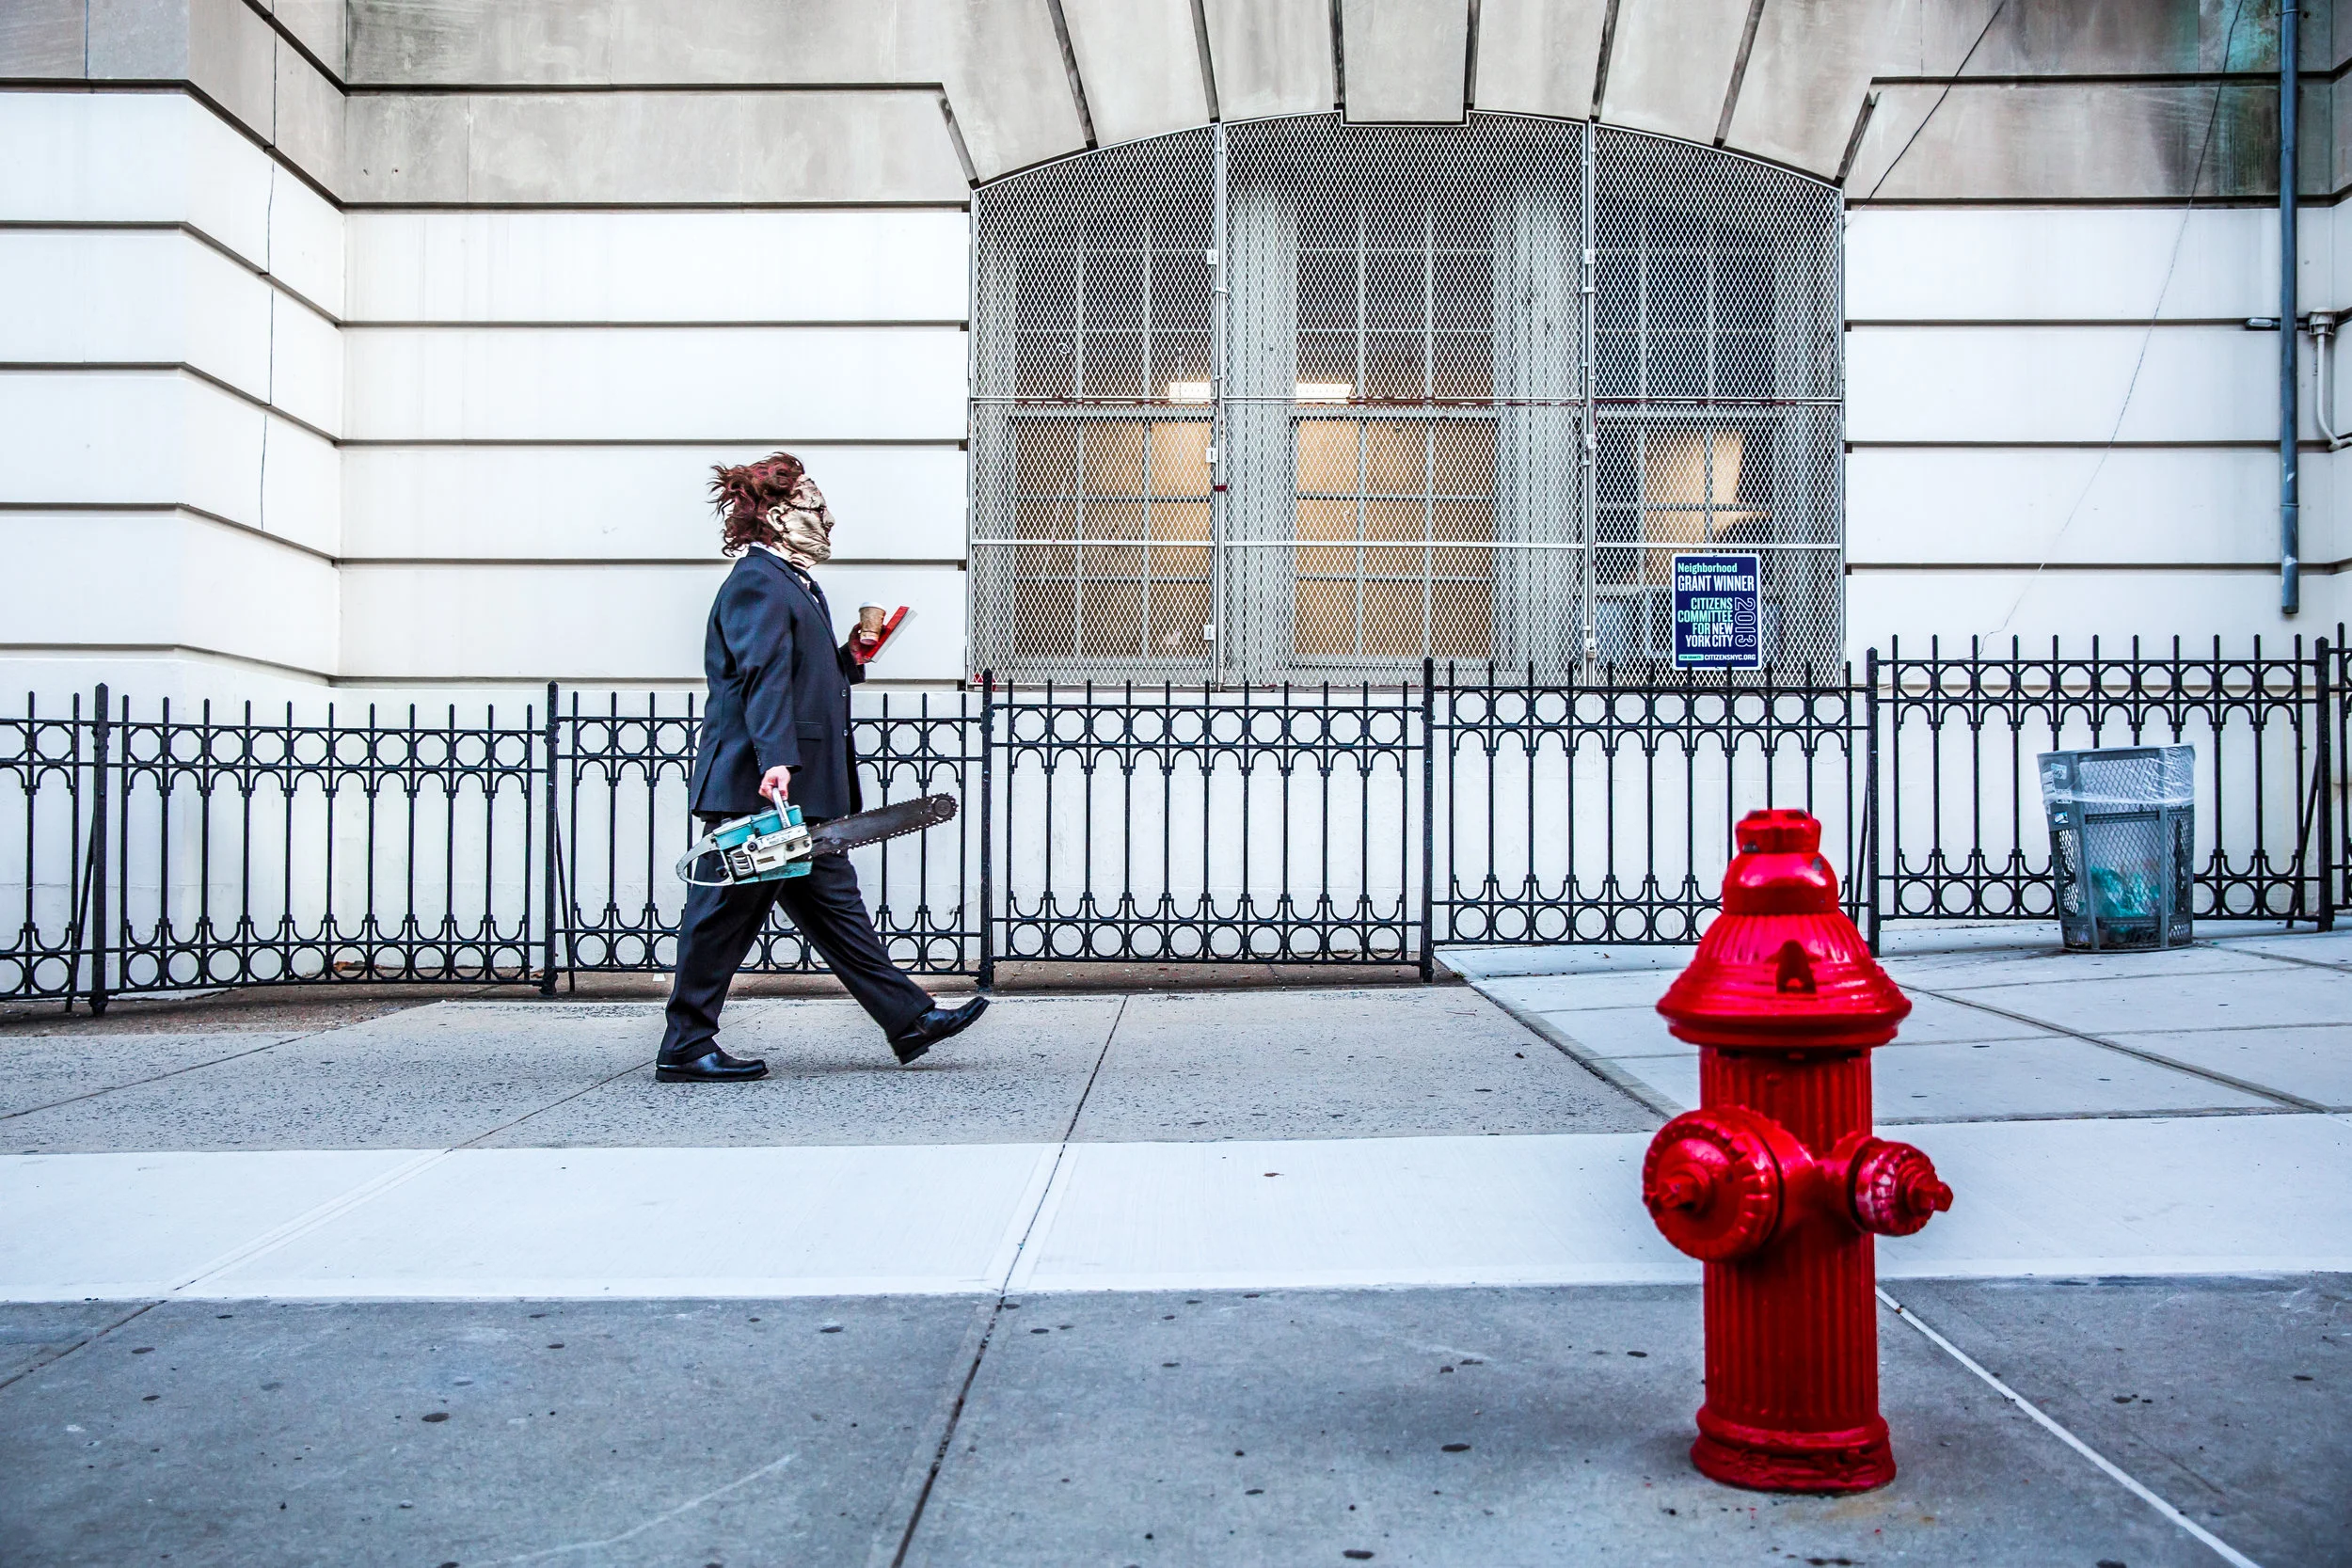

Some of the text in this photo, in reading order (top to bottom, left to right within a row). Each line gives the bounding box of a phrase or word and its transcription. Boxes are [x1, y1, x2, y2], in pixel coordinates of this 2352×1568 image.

[1677, 562, 1738, 575] Neighborhood
[1677, 575, 1755, 592] GRANT WINNER
[1691, 597, 1733, 610] CITIZENS
[1677, 610, 1733, 623] COMMITTEE
[1735, 597, 1756, 647] 2013
[1692, 623, 1733, 635] FOR NEW
[1685, 635, 1733, 647] YORK CITY
